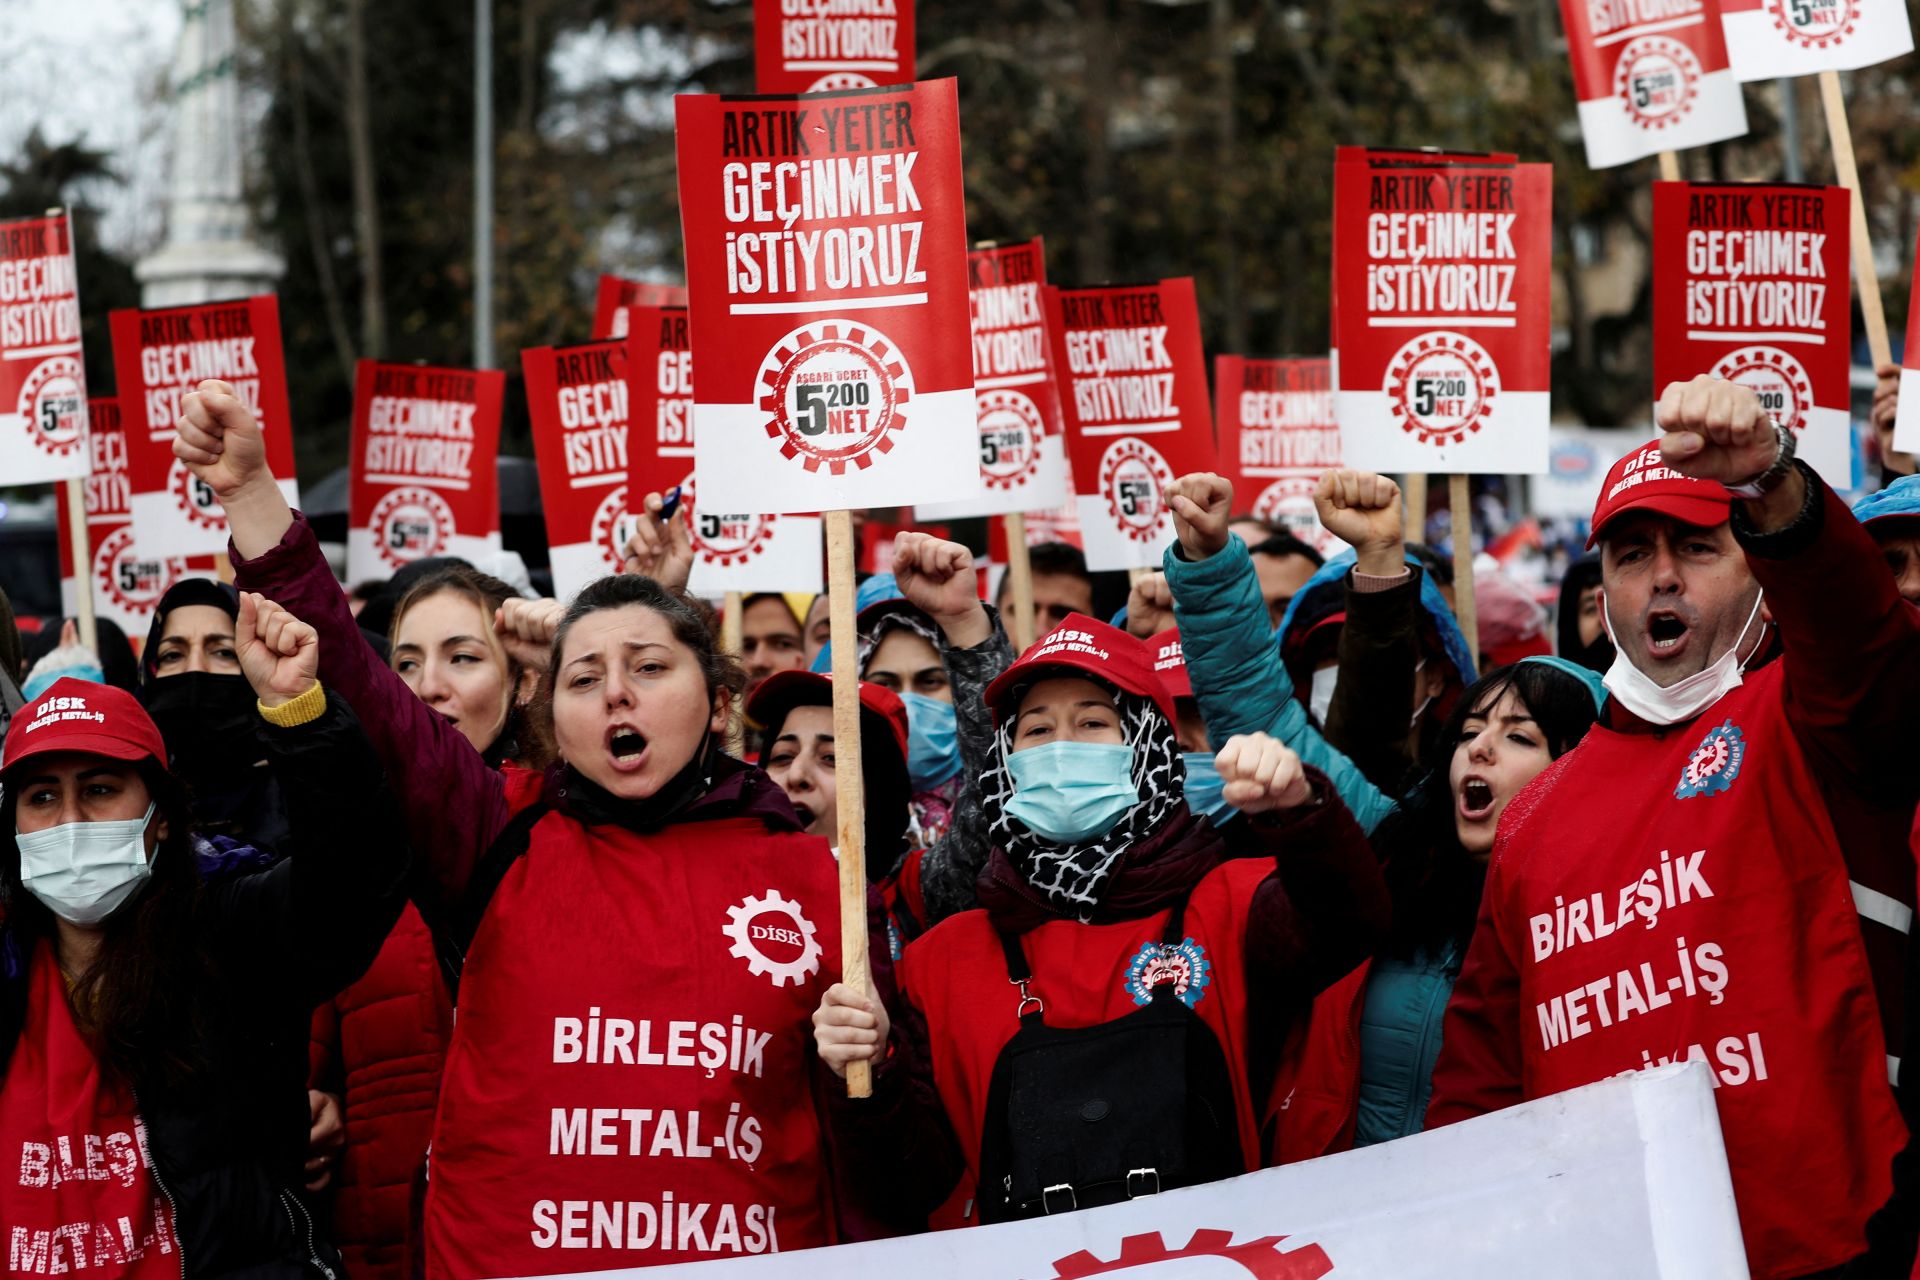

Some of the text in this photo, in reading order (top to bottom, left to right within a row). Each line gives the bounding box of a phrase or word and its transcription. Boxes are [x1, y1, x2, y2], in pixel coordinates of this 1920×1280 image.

[1790, 0, 1811, 26] 5
[781, 18, 899, 58] İSTİYORUZ
[1634, 78, 1649, 107] 5
[722, 101, 916, 158] ARTIK YETER
[723, 151, 922, 229] GEÇİNMEK
[1369, 175, 1515, 211] ARTIK YETER
[1687, 193, 1825, 230] ARTIK YETER
[1368, 211, 1517, 266] GEÇİNMEK
[1687, 230, 1826, 281] GEÇİNMEK
[725, 221, 927, 295] İSTİYORUZ
[1367, 264, 1517, 312] İSTİYORUZ
[1687, 280, 1826, 330] İSTİYORUZ
[140, 306, 254, 344] ARTIK YETER
[1062, 292, 1166, 327] ARTIK YETER
[141, 337, 259, 390] GEÇİNMEK
[556, 352, 615, 386] ARTIK
[1064, 326, 1173, 377] GEÇİNMEK
[43, 400, 57, 431] 5
[796, 382, 870, 436] 5 200
[1072, 373, 1180, 421] İSTİYORUZ
[1416, 380, 1466, 416] 5 200
[1436, 400, 1465, 417] NET
[828, 409, 870, 435] NET
[365, 434, 474, 479] İSTİYORUZ
[981, 434, 997, 465] 5
[1622, 449, 1662, 476] DİS
[196, 479, 213, 507] 5
[1120, 483, 1136, 515] 5
[391, 522, 406, 548] 5
[722, 524, 749, 539] NET
[120, 562, 136, 591] 5
[1043, 628, 1095, 646] DİSK
[37, 696, 86, 718] DİSK
[1529, 849, 1714, 963] BİRLEŞİK
[751, 924, 803, 947] DİSK
[1536, 936, 1729, 1051] METAL-İŞ
[552, 1006, 773, 1078] BİRLEŞİK
[549, 1102, 763, 1171] METAL-İŞ
[530, 1191, 779, 1253] SENDİKASI
